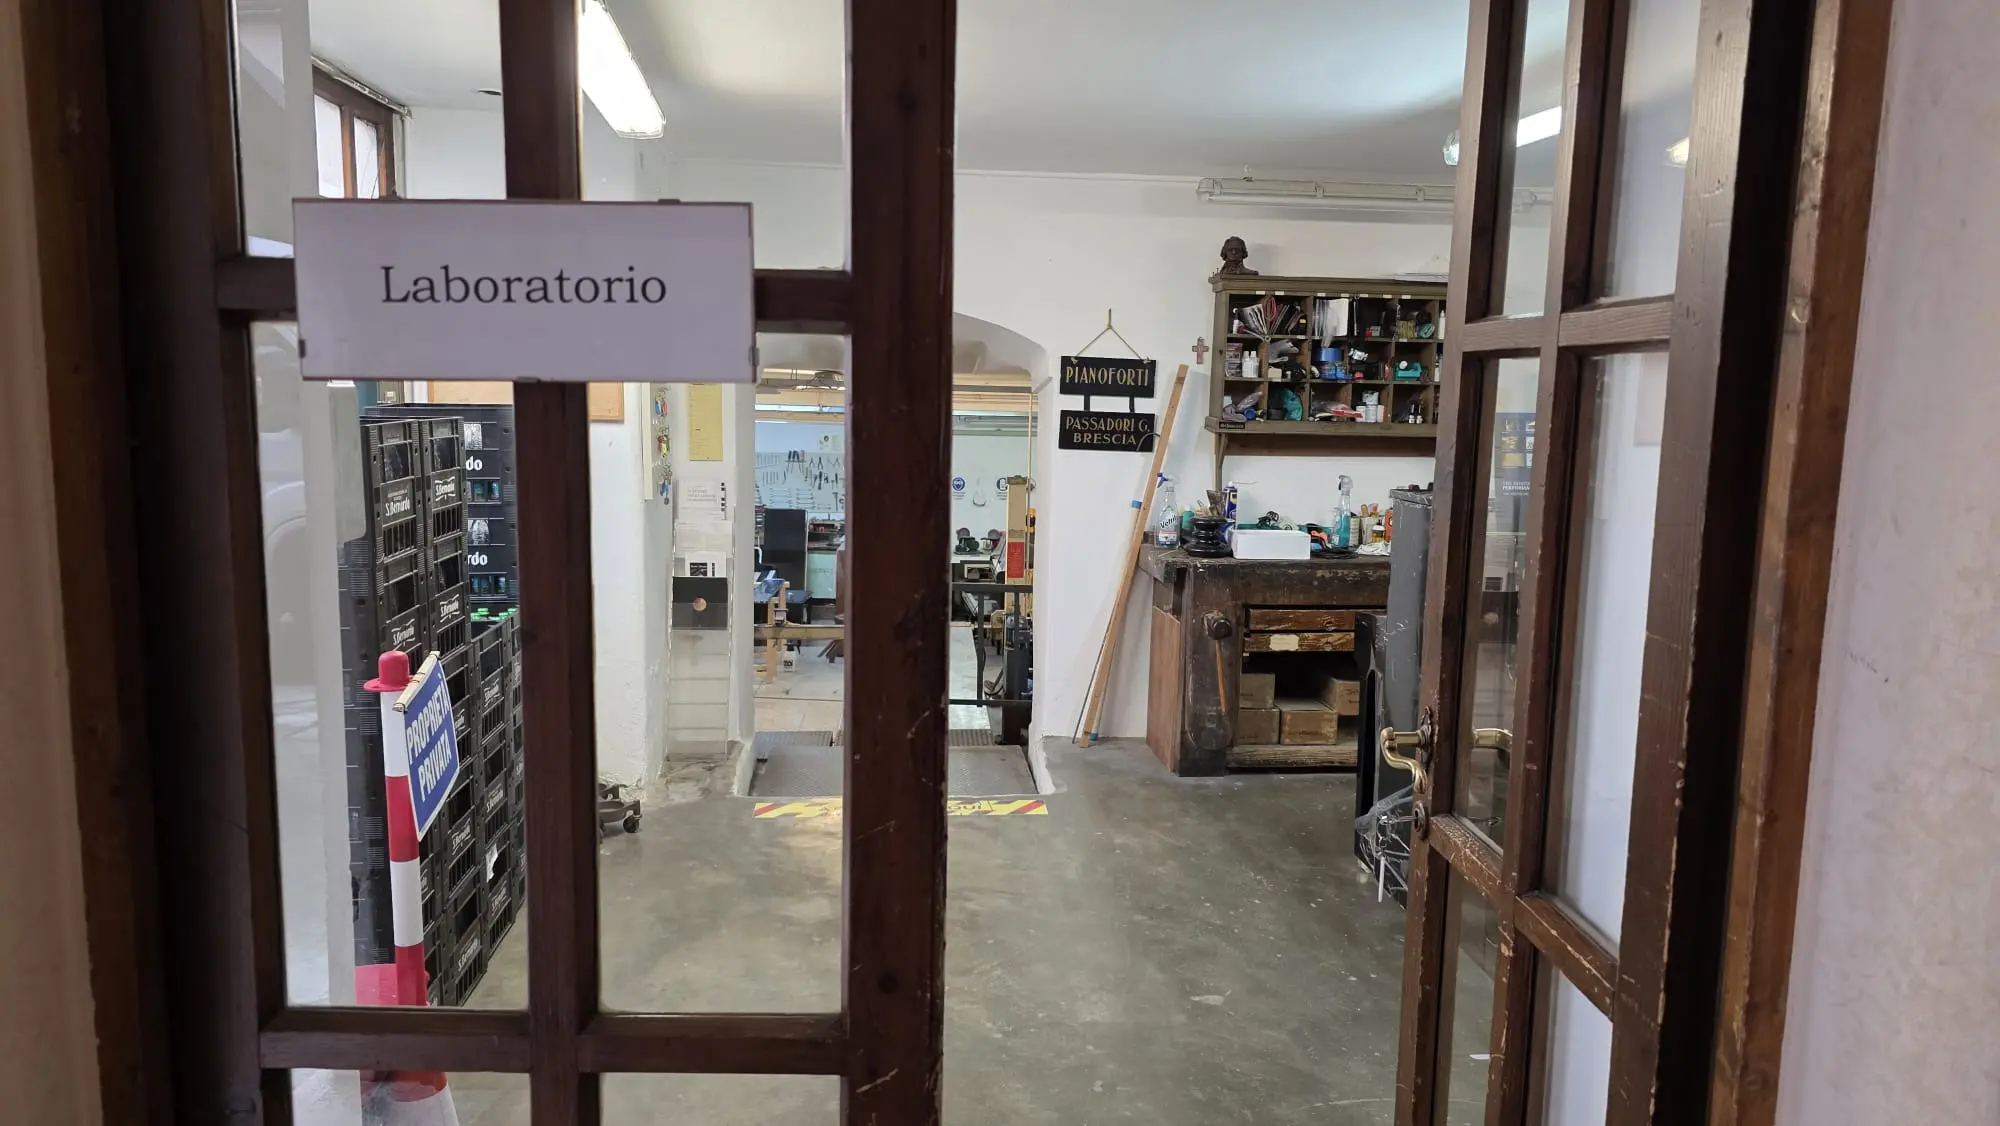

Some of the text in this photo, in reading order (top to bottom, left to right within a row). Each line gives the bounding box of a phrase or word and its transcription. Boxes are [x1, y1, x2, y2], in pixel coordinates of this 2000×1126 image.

[380, 265, 667, 303] Laboratorio
[1065, 366, 1149, 387] PIANOFORTI
[1065, 416, 1135, 432] PASSADORI
[1073, 432, 1137, 445] BRESCIA
[417, 728, 452, 803] PRIVATA
